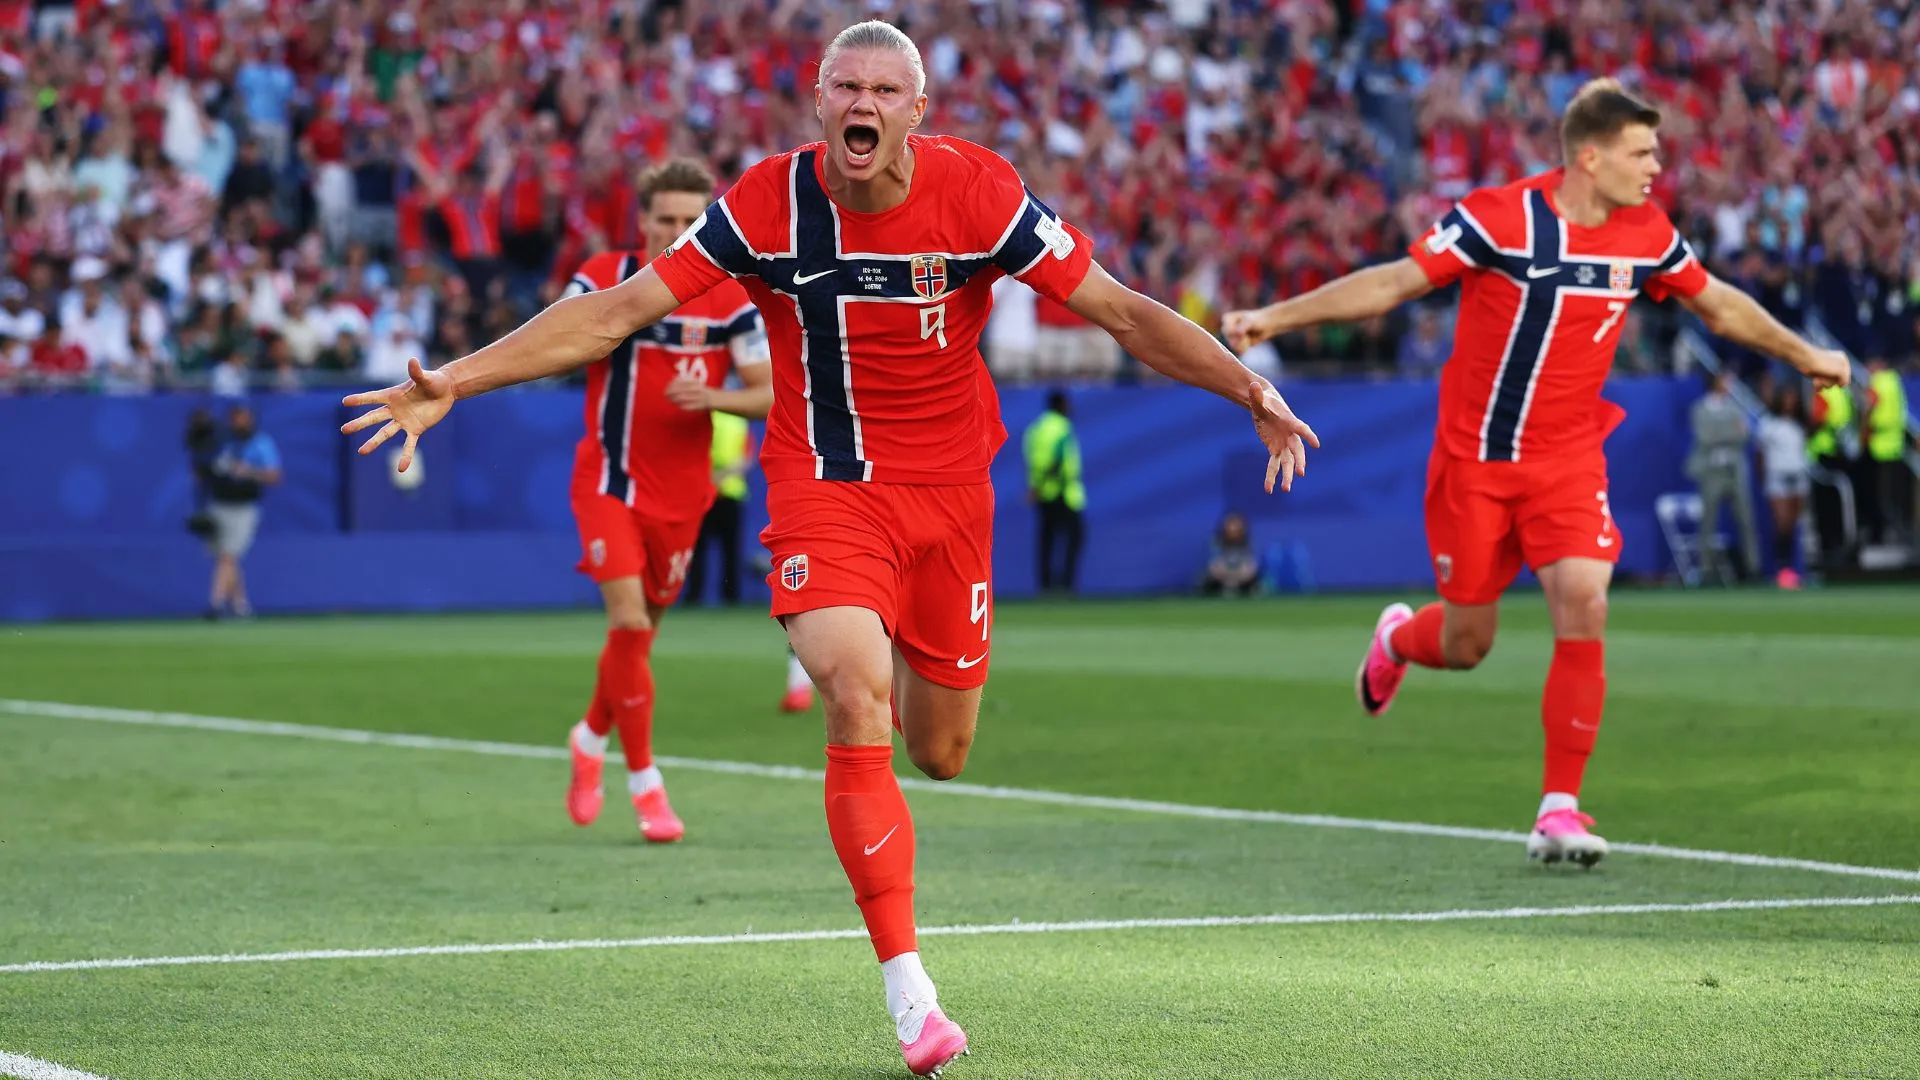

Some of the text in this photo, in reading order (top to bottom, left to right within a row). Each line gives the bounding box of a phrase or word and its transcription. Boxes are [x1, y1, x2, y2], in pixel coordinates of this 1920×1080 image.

[919, 302, 948, 349] 9
[1592, 301, 1625, 343] 7
[969, 580, 988, 642] 9
